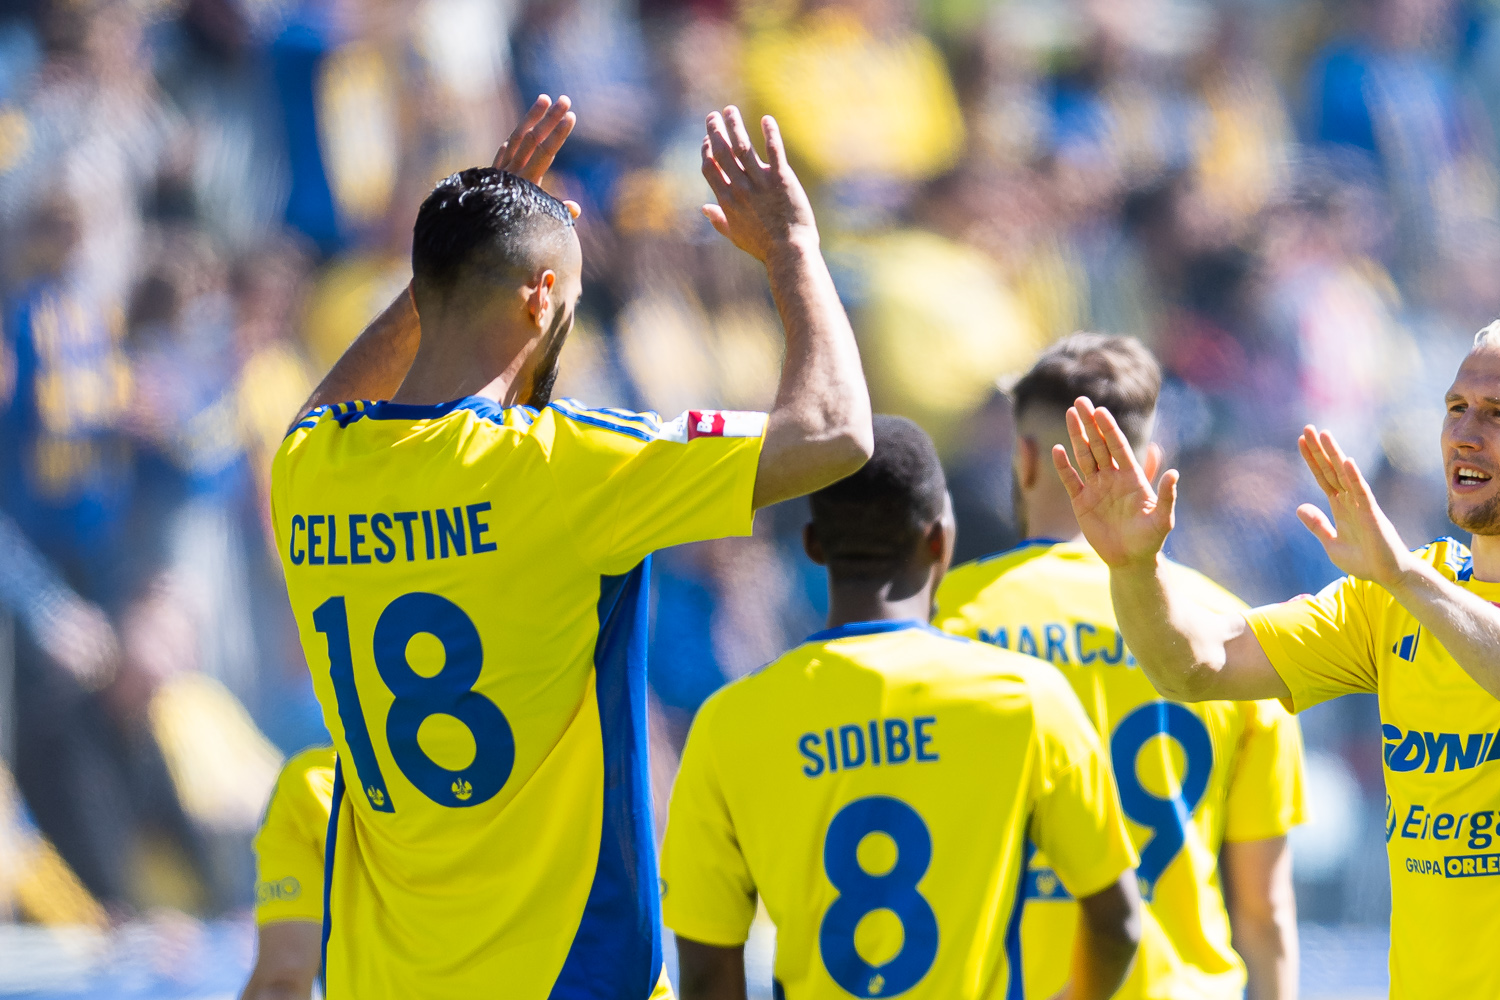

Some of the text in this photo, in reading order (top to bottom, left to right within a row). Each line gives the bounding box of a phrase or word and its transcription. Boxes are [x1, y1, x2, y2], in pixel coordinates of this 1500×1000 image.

[290, 501, 497, 565] CELESTINE
[313, 592, 515, 813] 18
[799, 716, 939, 778] SIDIBE
[820, 796, 939, 999] 8
[1406, 857, 1442, 876] GRUPA
